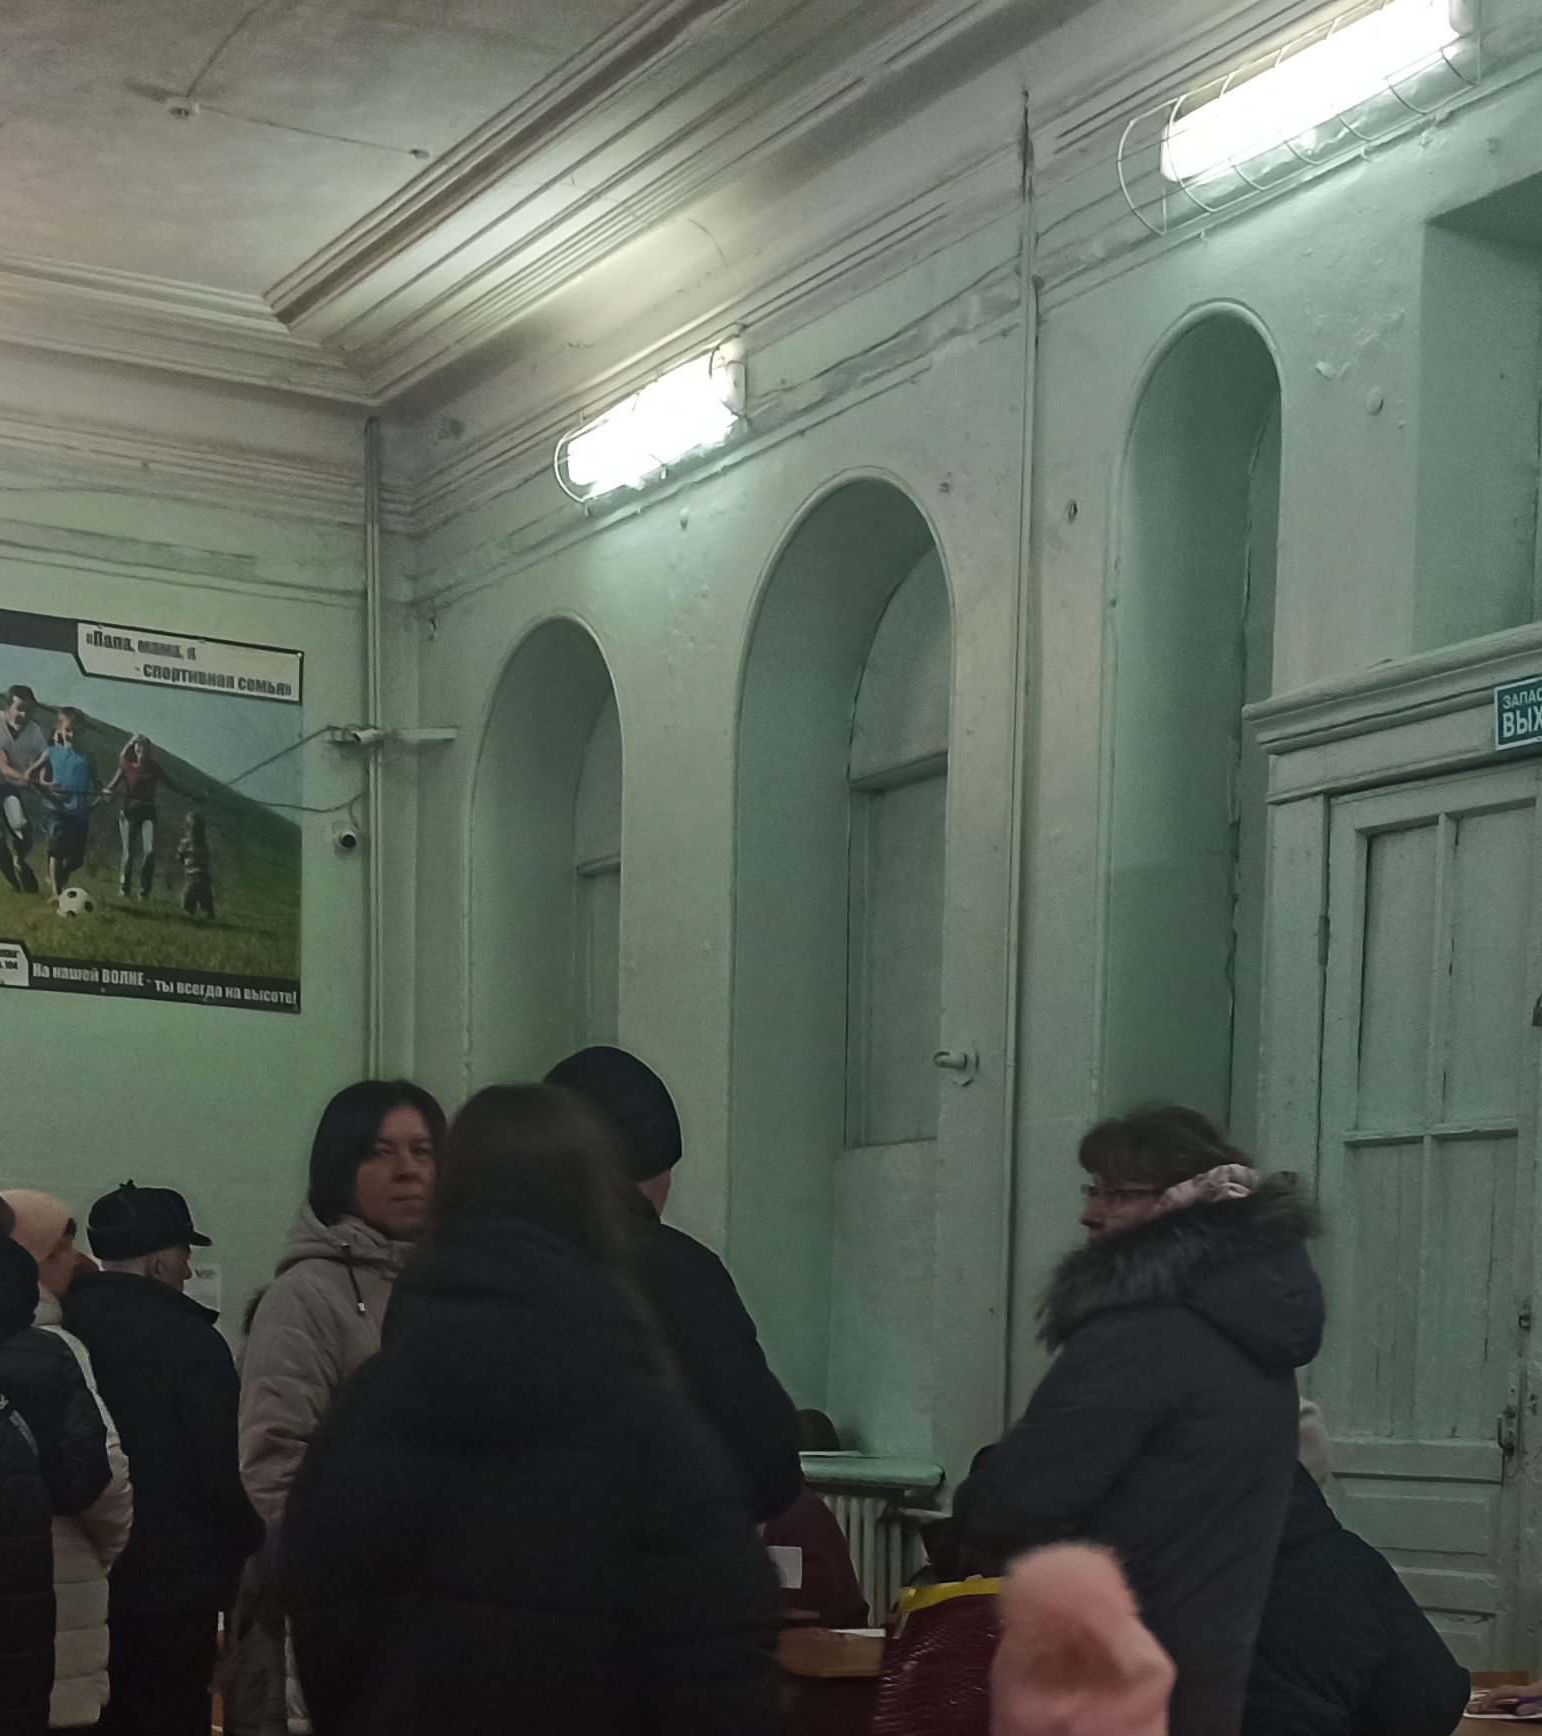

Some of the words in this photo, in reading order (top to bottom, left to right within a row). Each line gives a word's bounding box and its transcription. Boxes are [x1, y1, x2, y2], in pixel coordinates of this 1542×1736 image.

[143, 663, 235, 690] спортивная
[32, 963, 50, 979] На
[52, 966, 100, 982] нашей
[101, 968, 145, 987] ВОЛНЕ
[154, 980, 174, 993] ты
[176, 982, 222, 1000] всегда
[225, 986, 241, 1000] на
[243, 987, 297, 1005] высоте!
